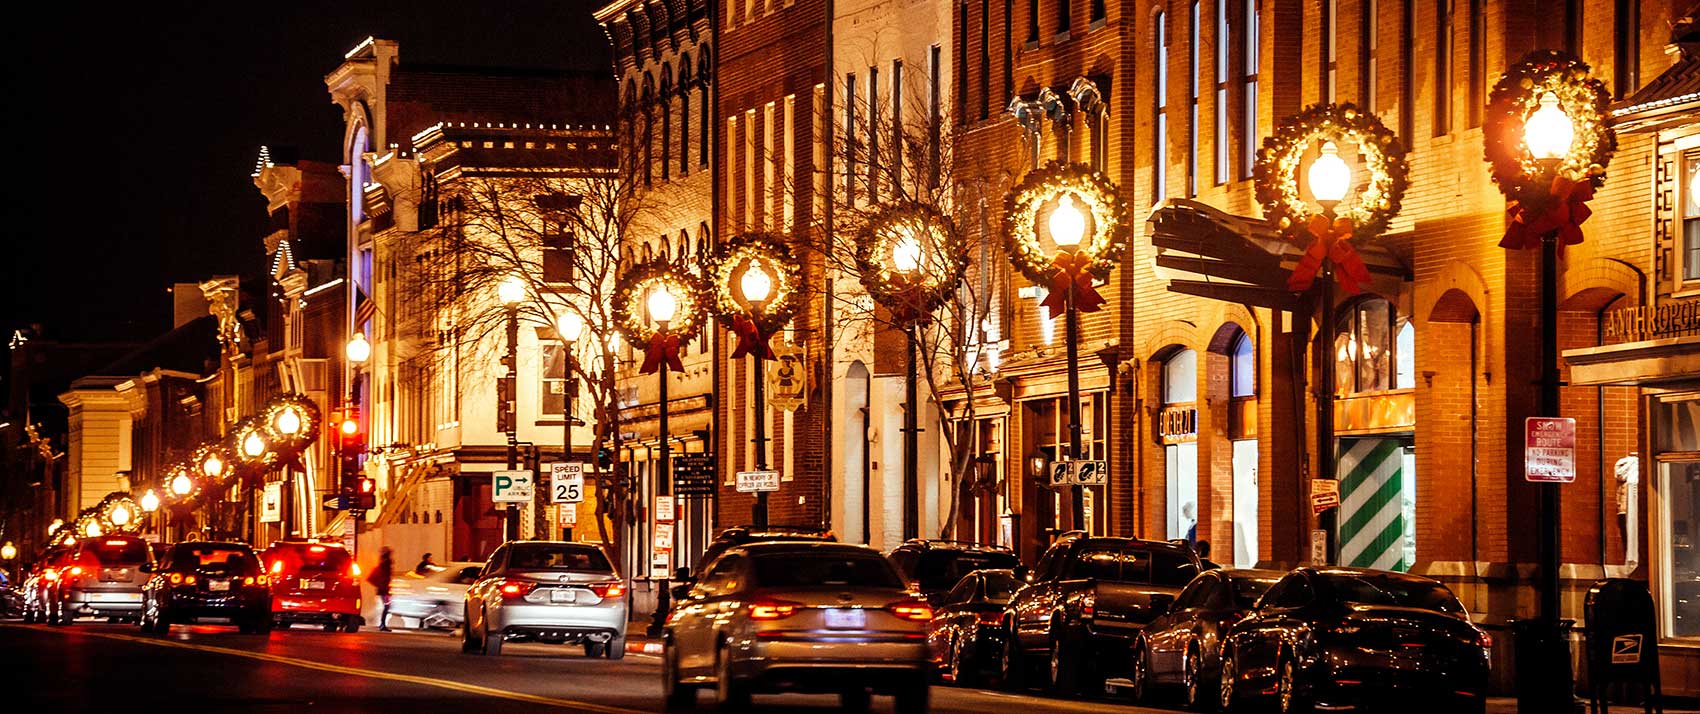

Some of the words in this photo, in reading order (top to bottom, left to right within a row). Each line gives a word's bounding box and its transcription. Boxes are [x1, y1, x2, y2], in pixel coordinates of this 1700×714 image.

[1536, 421, 1562, 430] SNOW
[1536, 438, 1561, 447] ROUTE
[554, 465, 580, 473] SPEED
[1099, 463, 1104, 471] 2
[557, 473, 577, 481] LIMIT
[495, 476, 512, 496] P
[557, 484, 579, 500] 25
